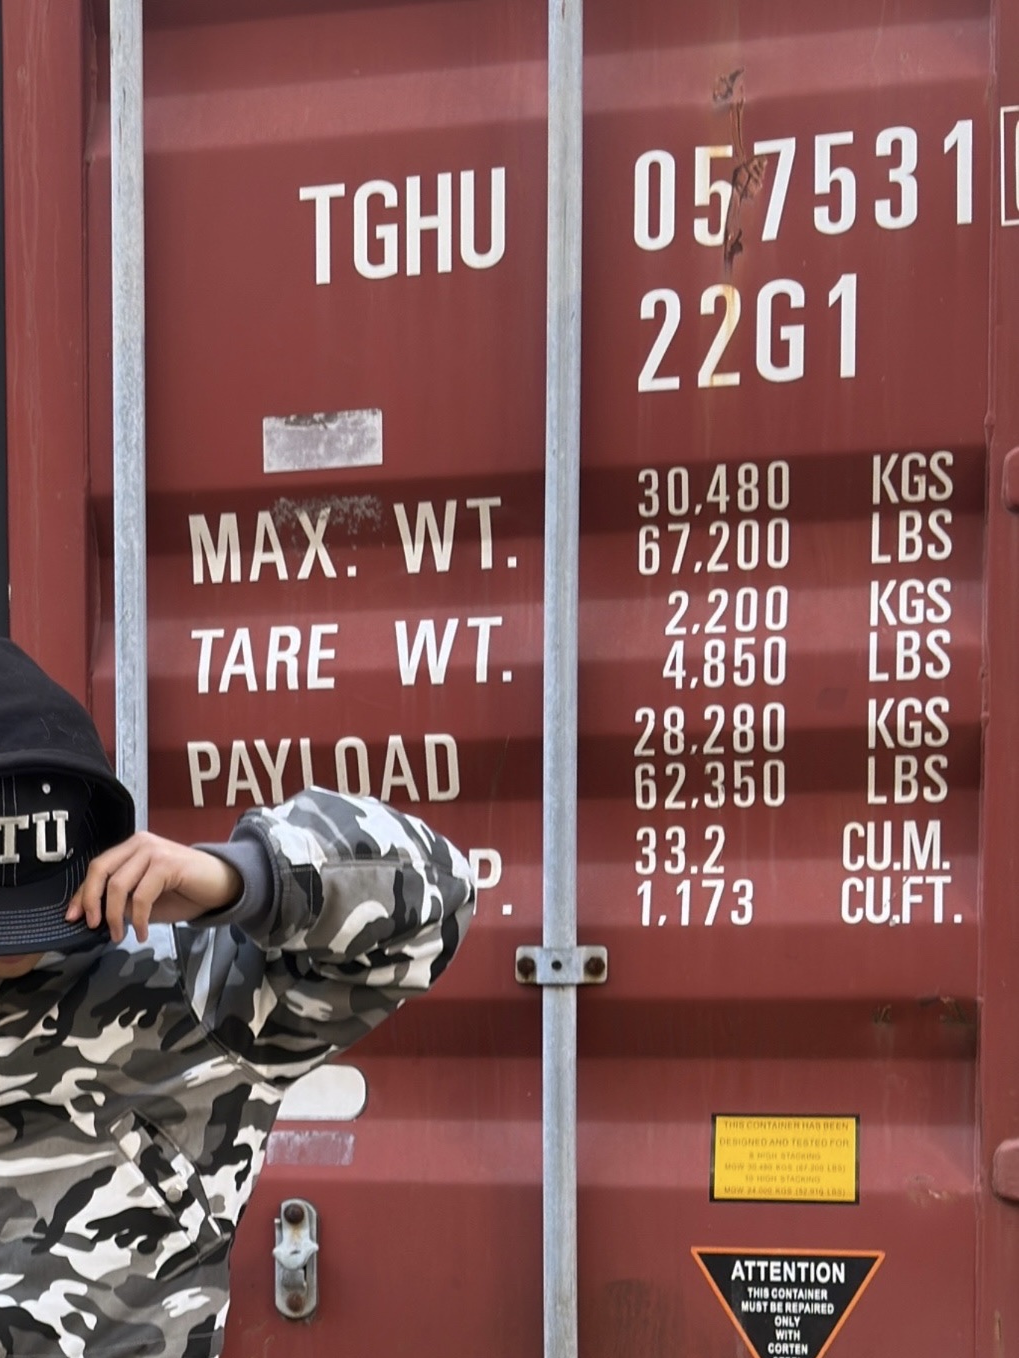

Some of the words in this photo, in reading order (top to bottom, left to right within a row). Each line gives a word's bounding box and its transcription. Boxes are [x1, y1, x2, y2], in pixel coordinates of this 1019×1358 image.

[299, 167, 505, 285] TGHU
[633, 119, 973, 251] 057531
[637, 273, 857, 393] 22G1
[638, 460, 790, 517] 30,480
[872, 451, 954, 505] KGS
[188, 506, 357, 585] MAX.
[393, 496, 517, 575] WT.
[638, 517, 790, 576] 67,200
[871, 508, 952, 564] LBS
[664, 585, 789, 636] 2,200
[869, 577, 952, 627] KGS
[190, 623, 339, 694] TARE
[394, 616, 513, 686] WT.
[662, 636, 787, 690] 4,850
[868, 629, 951, 682] LBS
[633, 702, 786, 757] 28,280
[867, 697, 950, 750] KGS
[634, 759, 786, 810] 62,350
[867, 754, 949, 805] LBS
[634, 825, 726, 875] 33.2
[636, 879, 754, 927] 1,173
[719, 1137, 767, 1147] DESIGNED
[746, 1121, 800, 1131] CONTAINER
[731, 1259, 846, 1284] ATTENTION
[747, 1287, 770, 1299] THIS
[771, 1288, 828, 1300] CONTAINER
[741, 1301, 768, 1313] MUST
[770, 1301, 783, 1313] BE
[785, 1302, 835, 1315] REPAIRED
[774, 1315, 801, 1328] ONLY
[767, 1342, 809, 1355] CORTEN
[775, 1329, 801, 1341] WITH
